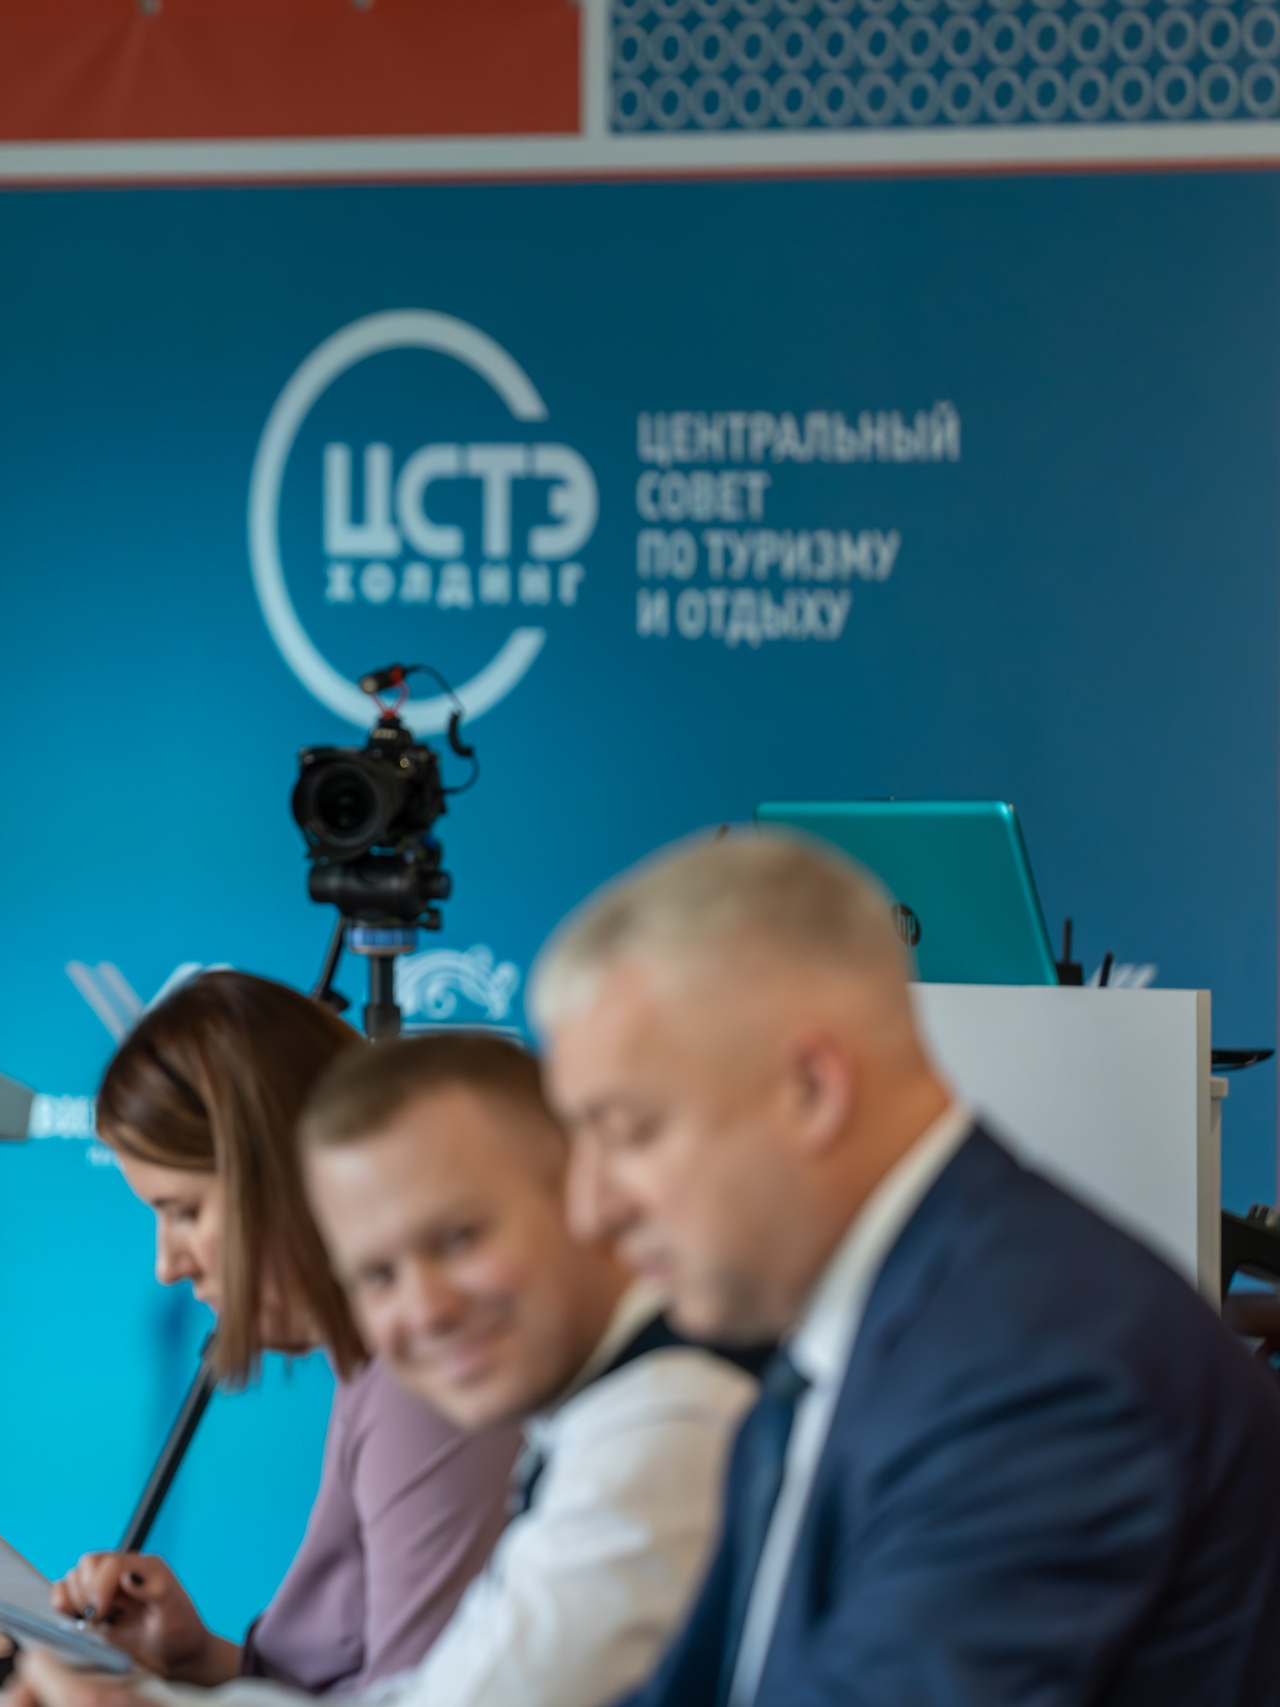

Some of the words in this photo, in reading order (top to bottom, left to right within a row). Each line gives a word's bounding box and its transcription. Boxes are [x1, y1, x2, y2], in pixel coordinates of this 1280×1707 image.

[637, 402, 960, 468] ЦЕНТРАЛЬНЫЙ
[323, 444, 599, 559] ЦСТЭ
[637, 471, 768, 522] СОВЕТ
[637, 531, 695, 580] ПО
[704, 531, 900, 580] ТУРИЗМУ
[325, 564, 583, 608] ХОЛДИНГ
[637, 591, 668, 638] И
[676, 591, 852, 646] ОТДЫХУ
